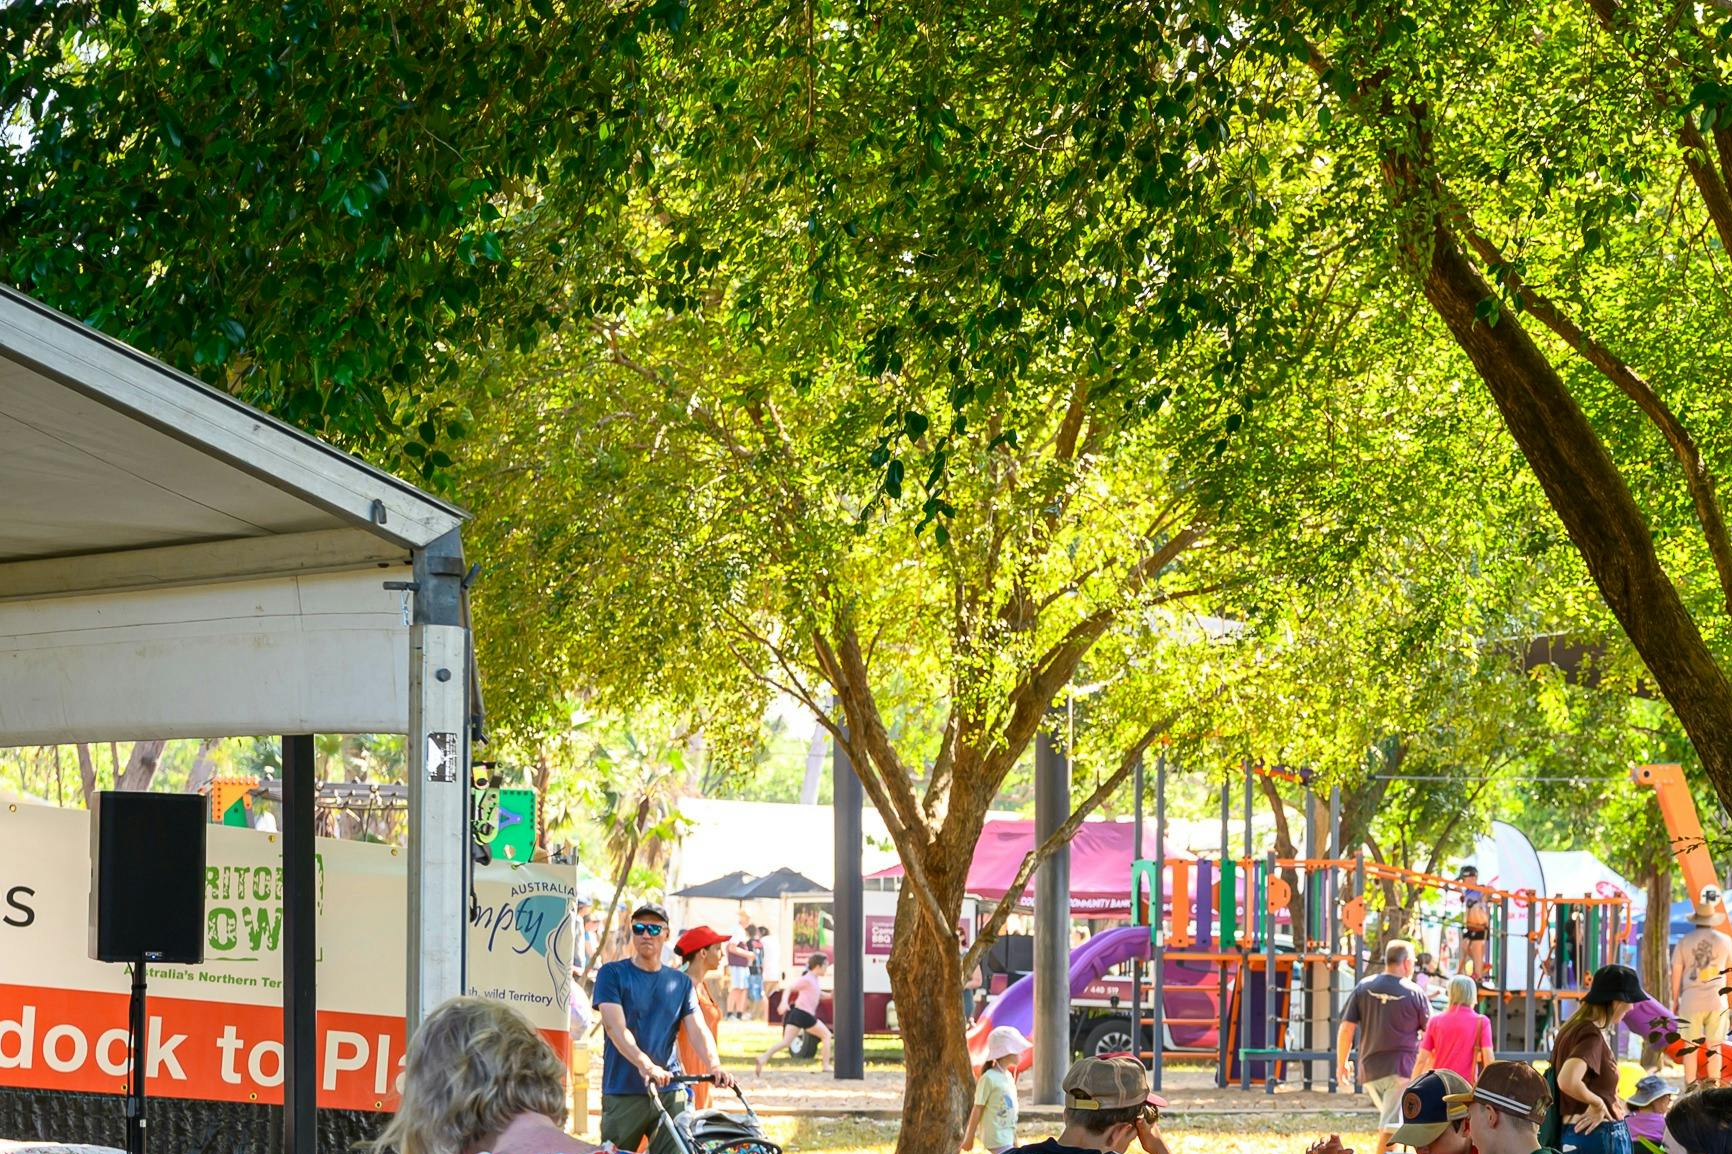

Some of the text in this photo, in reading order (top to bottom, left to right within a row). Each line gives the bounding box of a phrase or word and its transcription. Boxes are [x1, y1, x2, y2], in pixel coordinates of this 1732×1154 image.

[198, 971, 257, 987] Northern
[484, 989, 506, 1000] wild
[508, 990, 553, 1007] Territory
[0, 1005, 188, 1080] dock
[216, 1025, 285, 1087] to
